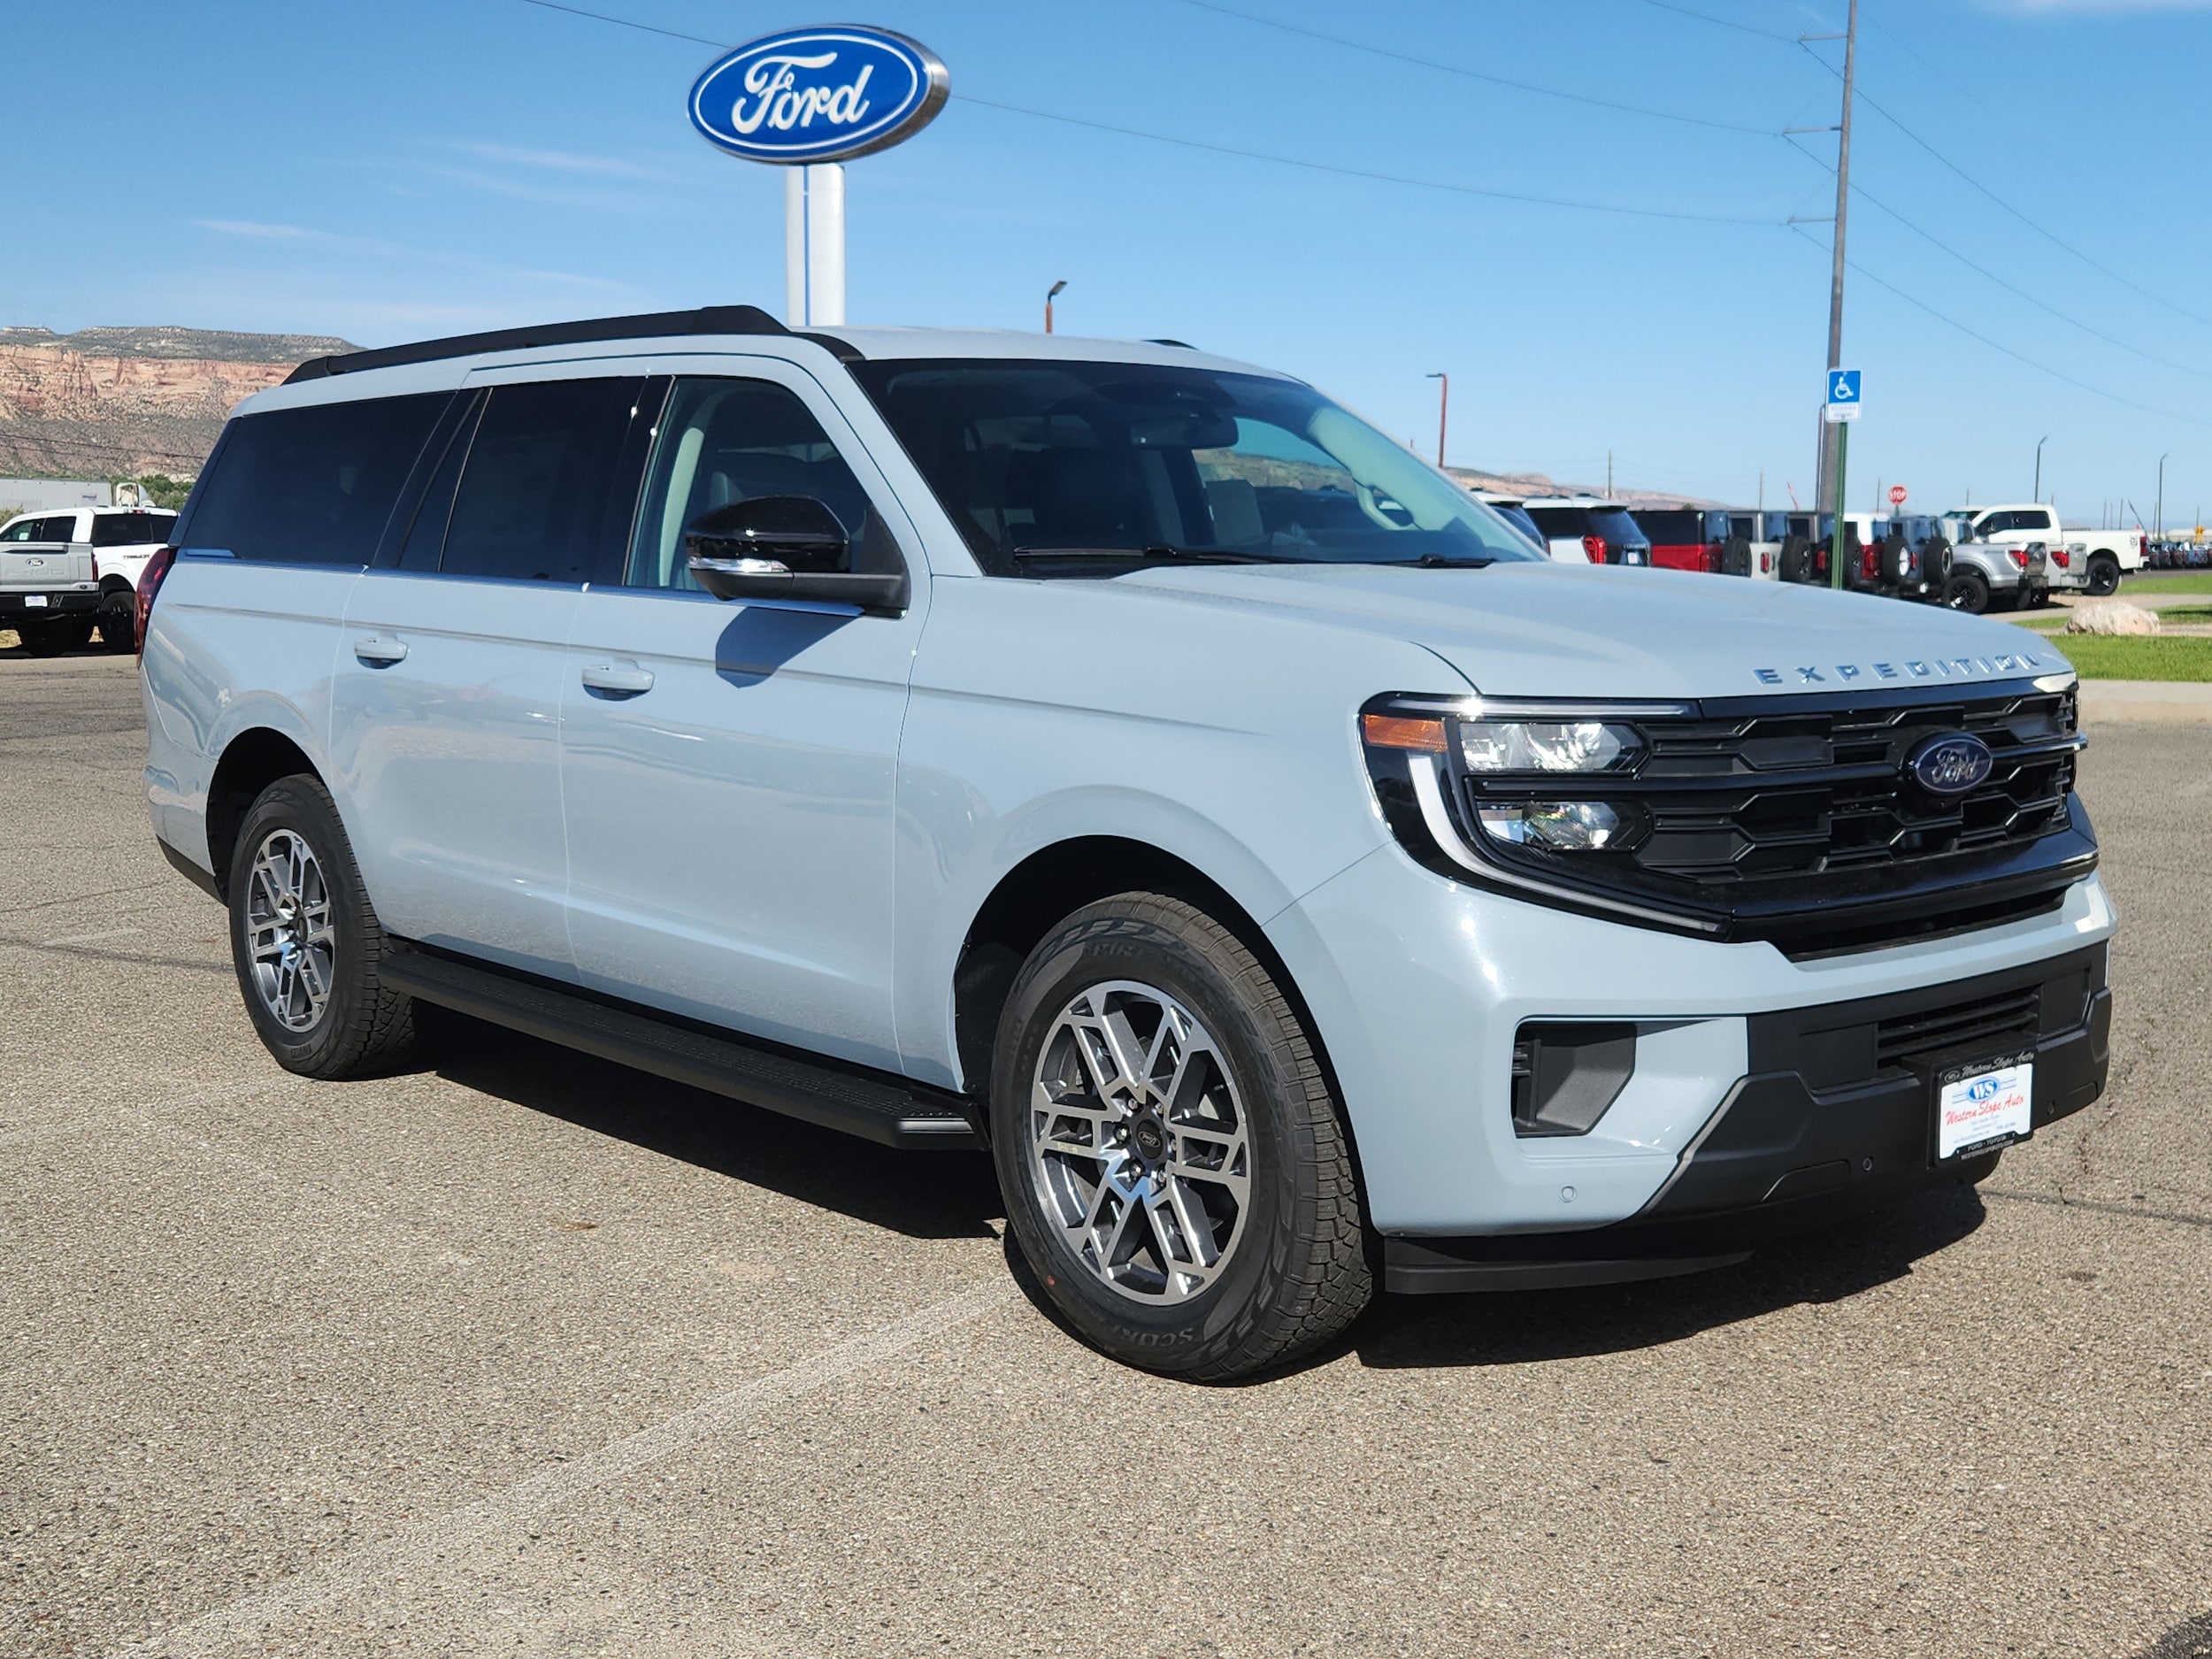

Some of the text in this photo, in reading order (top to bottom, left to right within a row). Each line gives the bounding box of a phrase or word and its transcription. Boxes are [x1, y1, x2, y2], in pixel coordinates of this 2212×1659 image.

[732, 51, 874, 134] Ford
[1888, 489, 1907, 500] STOP
[1753, 653, 2039, 686] EXPEDITION
[1931, 747, 1979, 783] Ford
[1973, 1080, 1994, 1099] WS
[1946, 1110, 1977, 1125] Western
[1978, 1101, 2001, 1116] Slope
[2003, 1094, 2024, 1109] Auto
